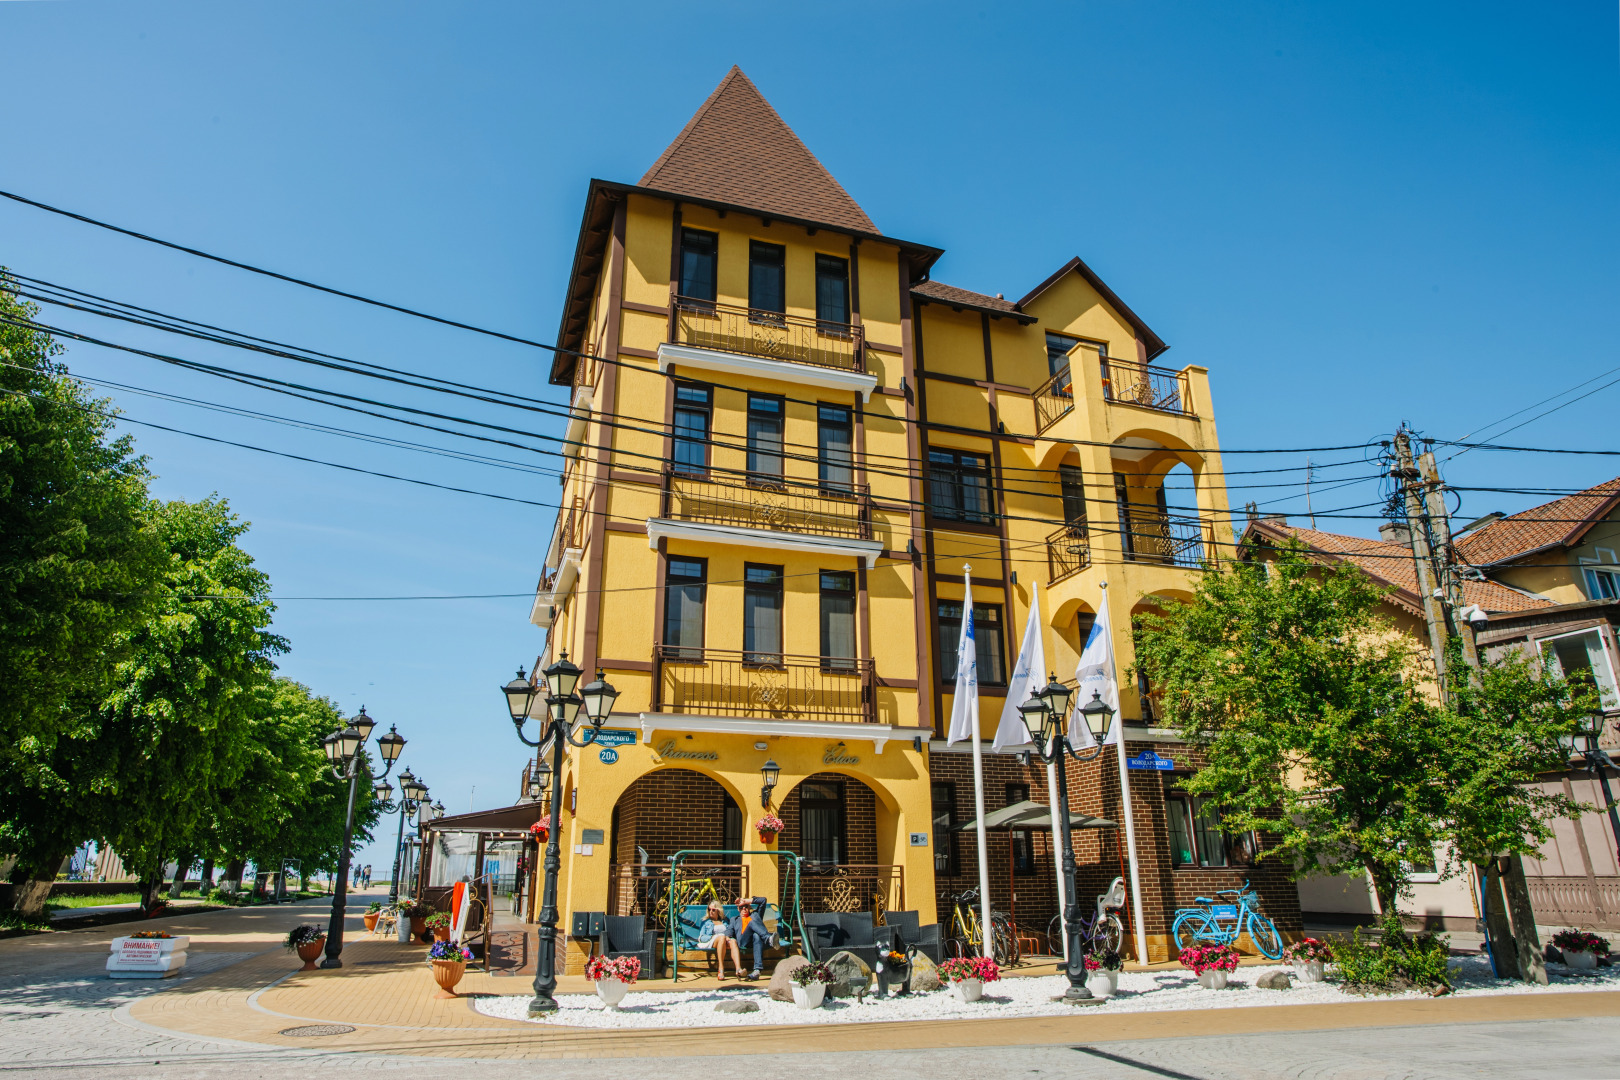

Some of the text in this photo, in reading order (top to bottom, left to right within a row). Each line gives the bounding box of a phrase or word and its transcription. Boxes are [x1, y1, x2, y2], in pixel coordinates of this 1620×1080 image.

[601, 751, 616, 761] 20А
[651, 739, 719, 761] Princess
[823, 744, 860, 765] Elisa
[123, 941, 161, 950] ВНИМАНИЕ!
